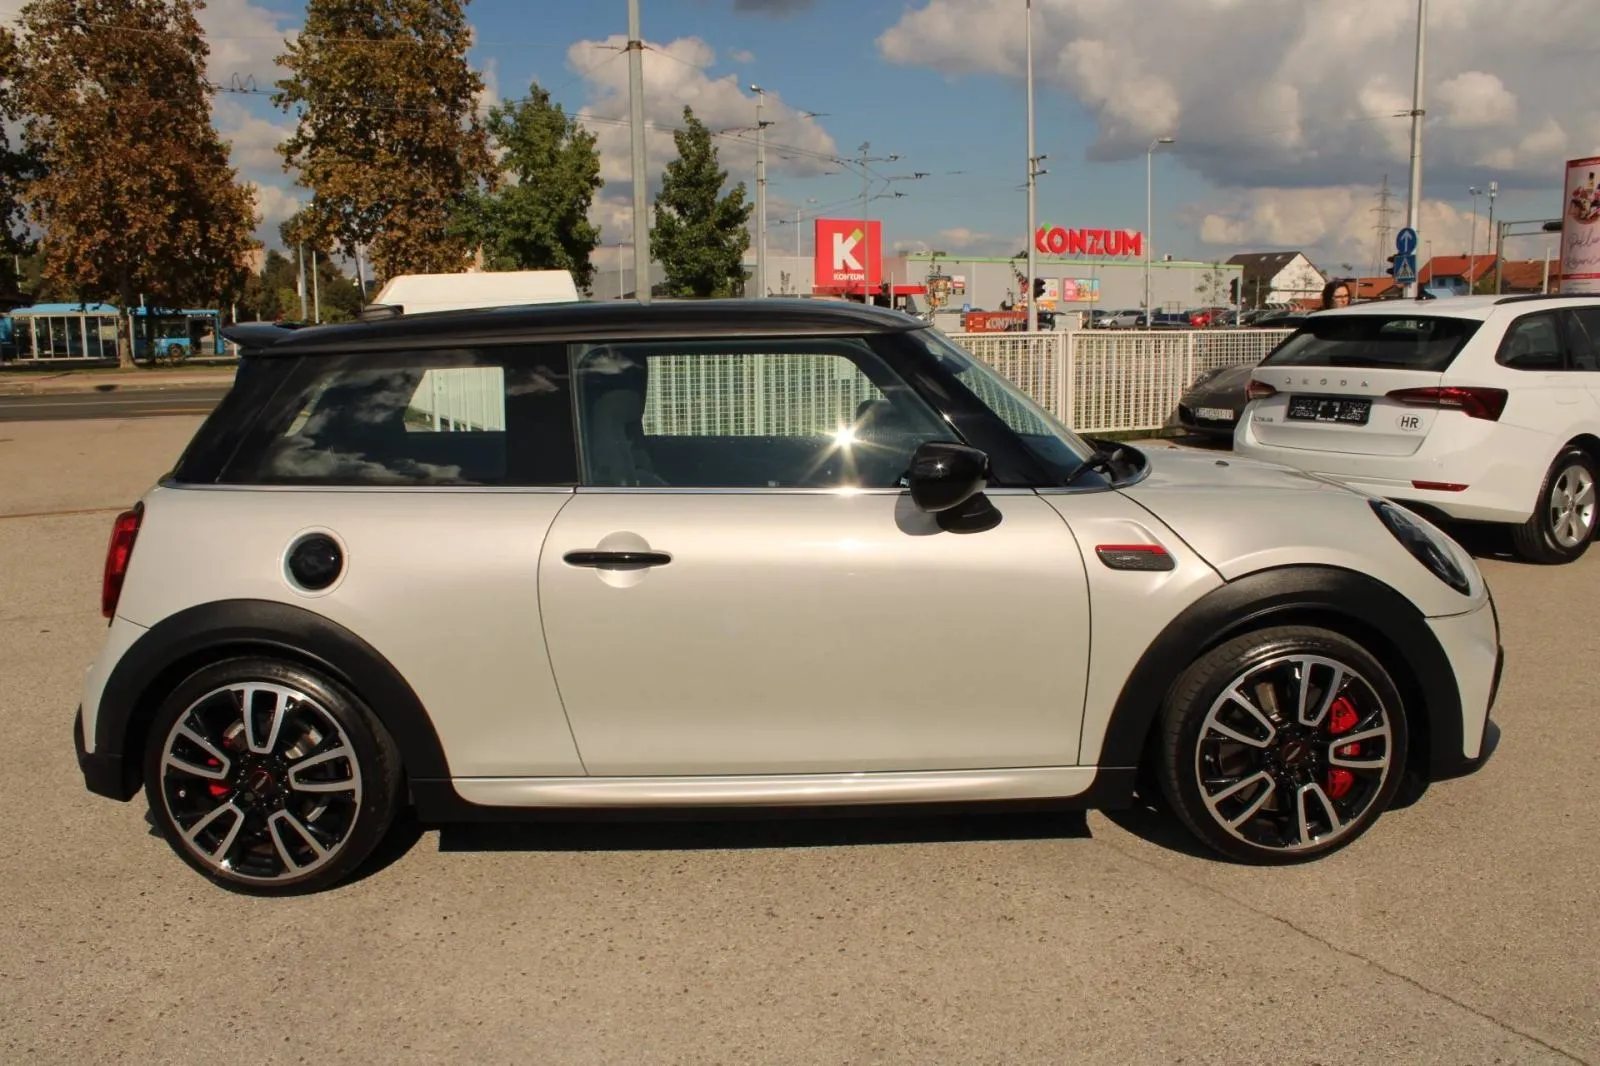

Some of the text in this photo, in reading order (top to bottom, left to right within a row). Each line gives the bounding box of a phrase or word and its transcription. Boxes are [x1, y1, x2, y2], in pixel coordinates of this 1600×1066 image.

[832, 228, 864, 270] K
[1035, 223, 1142, 256] KONZUM
[1400, 416, 1419, 429] HR
